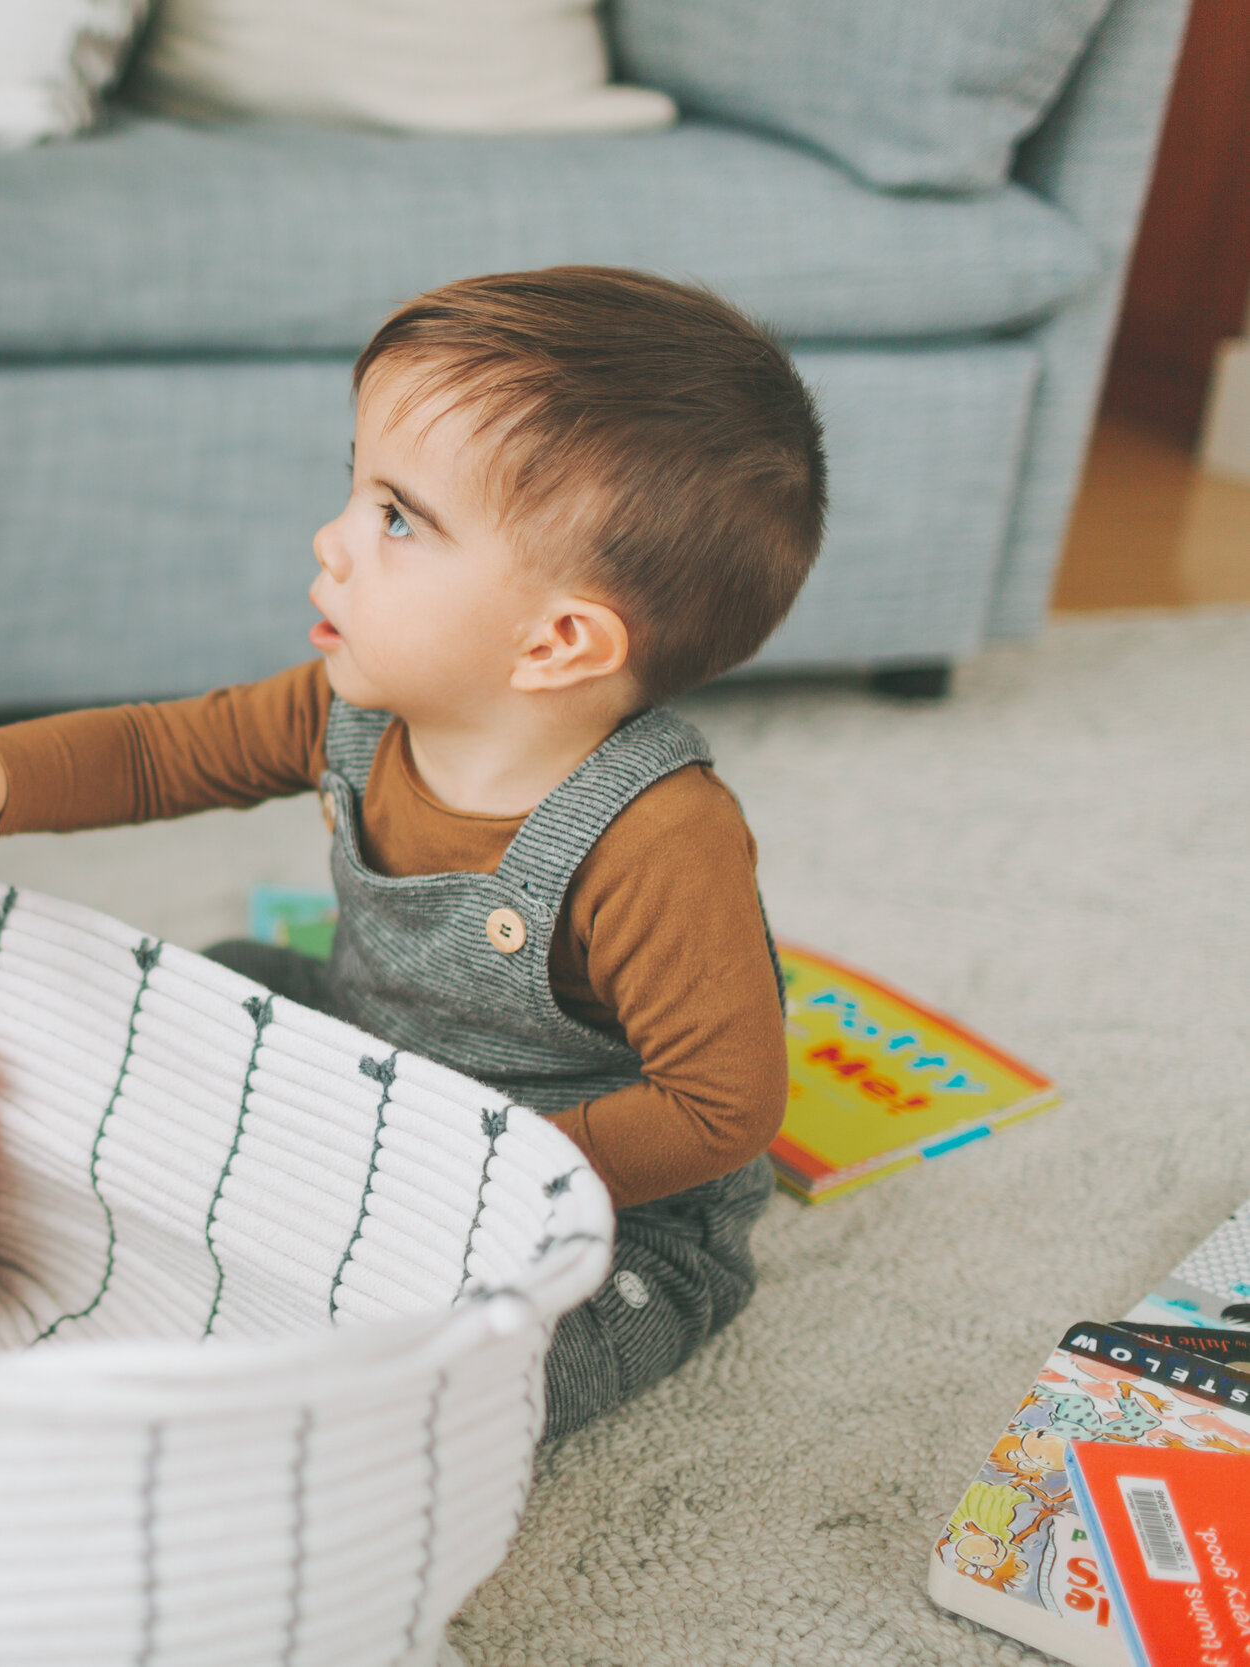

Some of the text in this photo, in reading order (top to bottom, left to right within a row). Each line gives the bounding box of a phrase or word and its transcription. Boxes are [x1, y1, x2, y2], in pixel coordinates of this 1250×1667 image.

[1070, 1334, 1249, 1403] STELOW
[1179, 1334, 1229, 1353] Julie
[1184, 1587, 1222, 1649] twins
[1223, 1585, 1250, 1637] very
